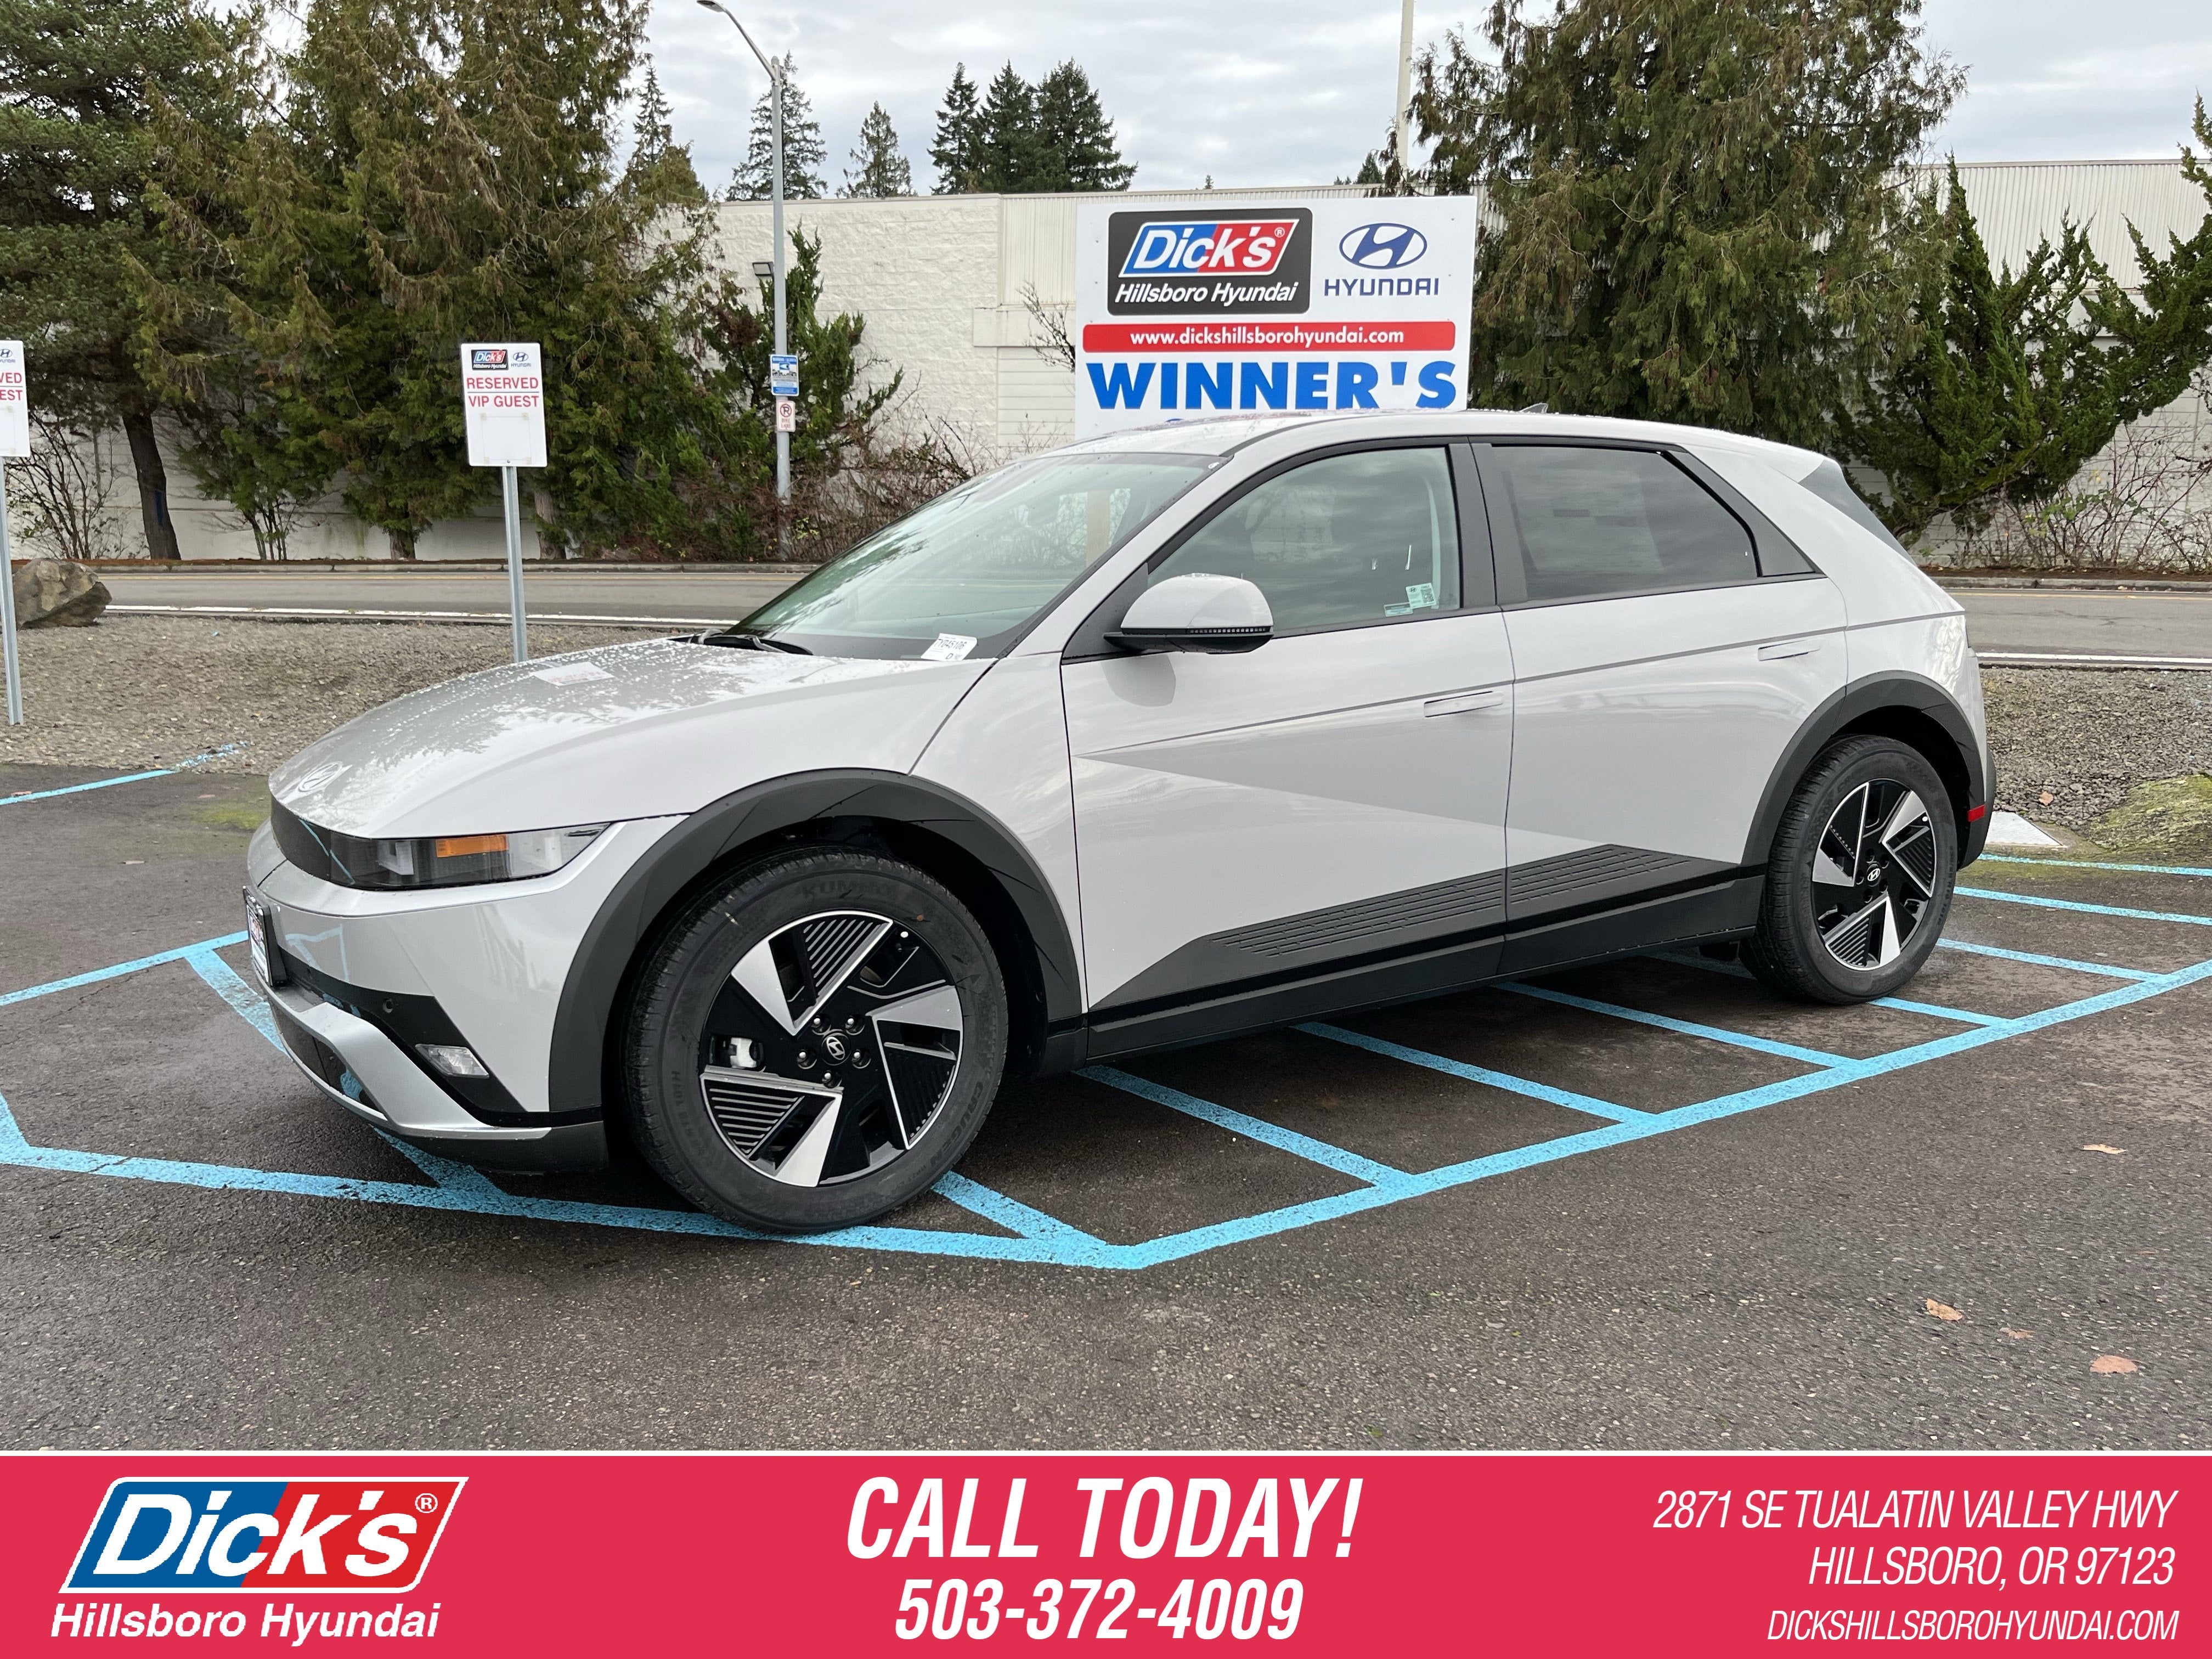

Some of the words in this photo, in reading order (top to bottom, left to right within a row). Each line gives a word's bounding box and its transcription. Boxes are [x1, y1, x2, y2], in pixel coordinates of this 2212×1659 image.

[1133, 225, 1274, 269] Dick's
[1115, 283, 1208, 303] Hillsboro
[1211, 281, 1299, 307] Hyundai
[1324, 277, 1438, 296] HYUNDAI
[1130, 325, 1404, 348] www.dickshillsborohyundai.com
[466, 377, 539, 389] RESERVED
[1086, 360, 1456, 410] WINNER'S
[468, 395, 490, 407] VIP
[494, 395, 539, 407] GUEST
